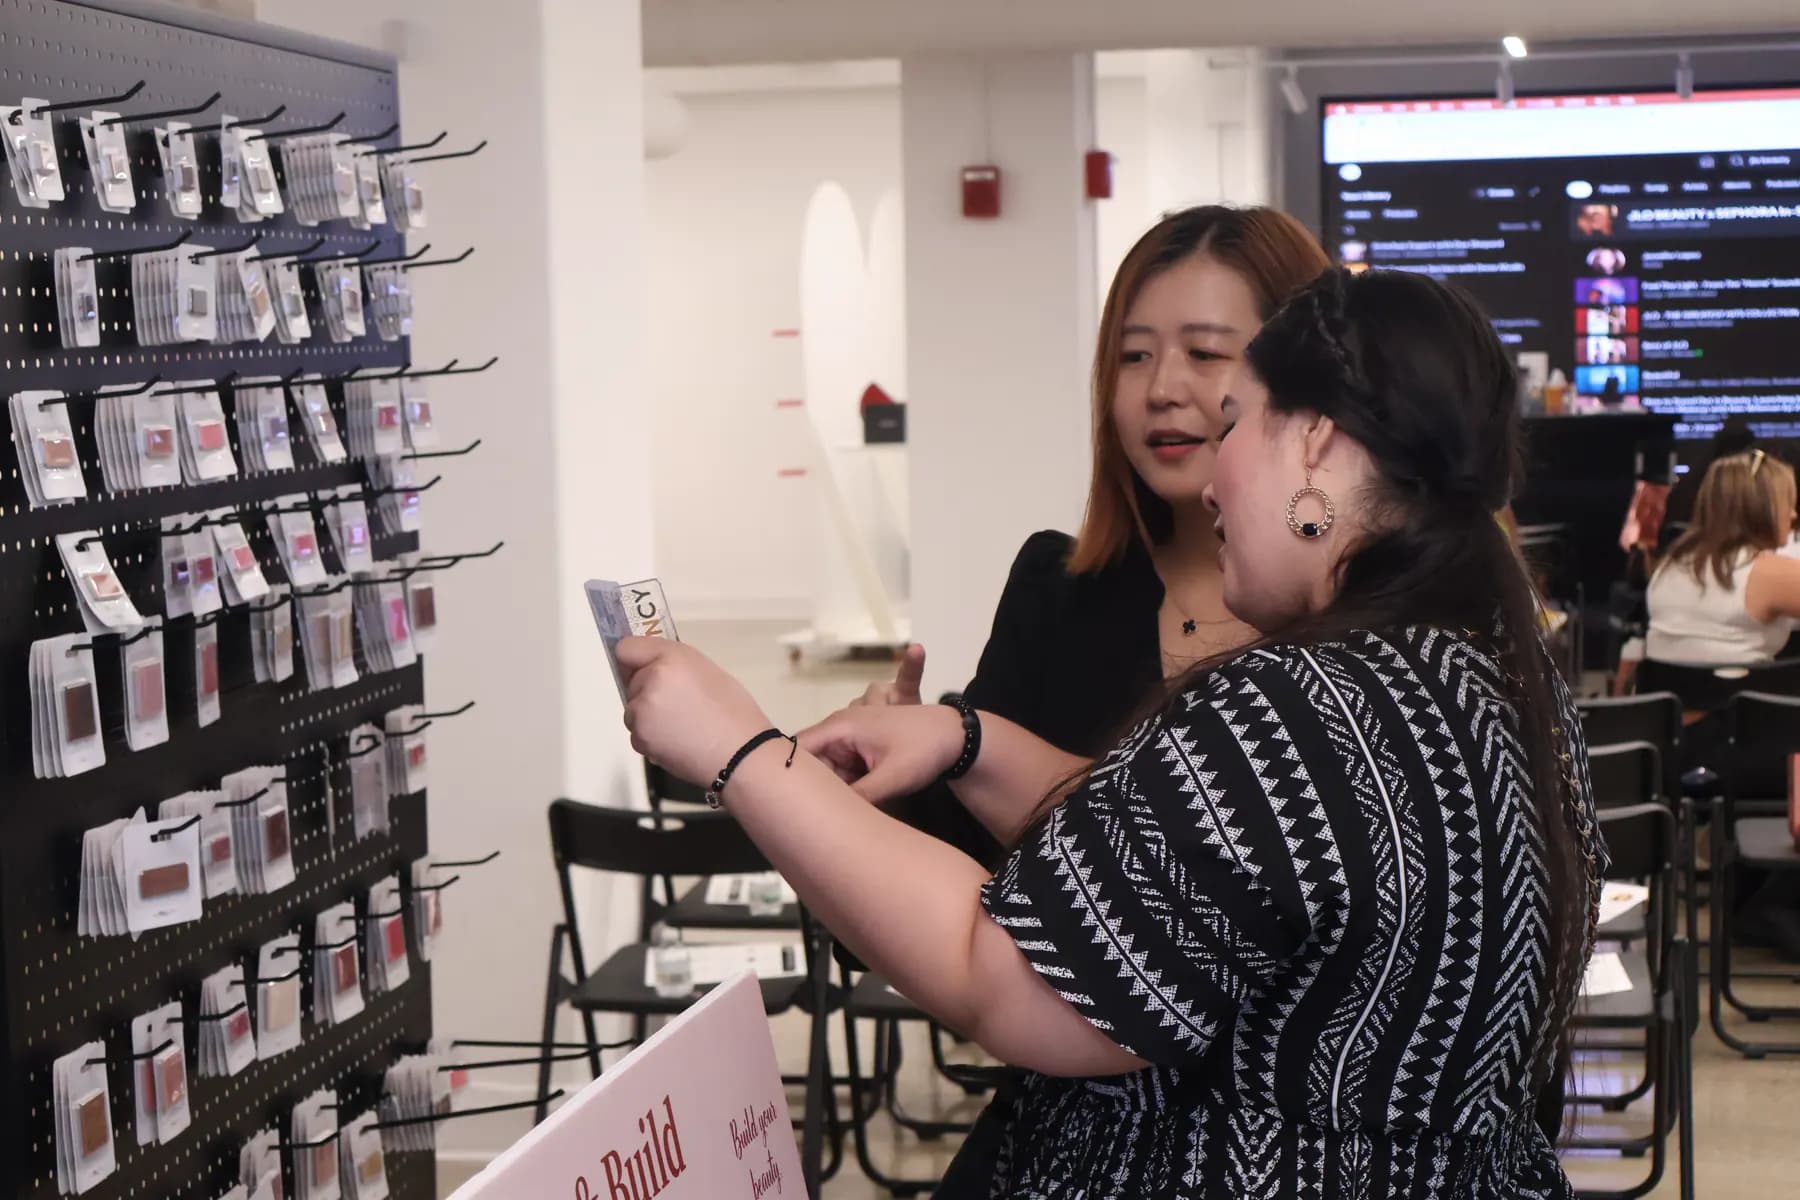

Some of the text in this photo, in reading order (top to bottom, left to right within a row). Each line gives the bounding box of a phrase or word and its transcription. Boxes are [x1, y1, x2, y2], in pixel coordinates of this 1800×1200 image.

[1715, 206, 1778, 220] SEPHORA
[600, 1095, 687, 1200] Build
[729, 1100, 777, 1161] Build your
